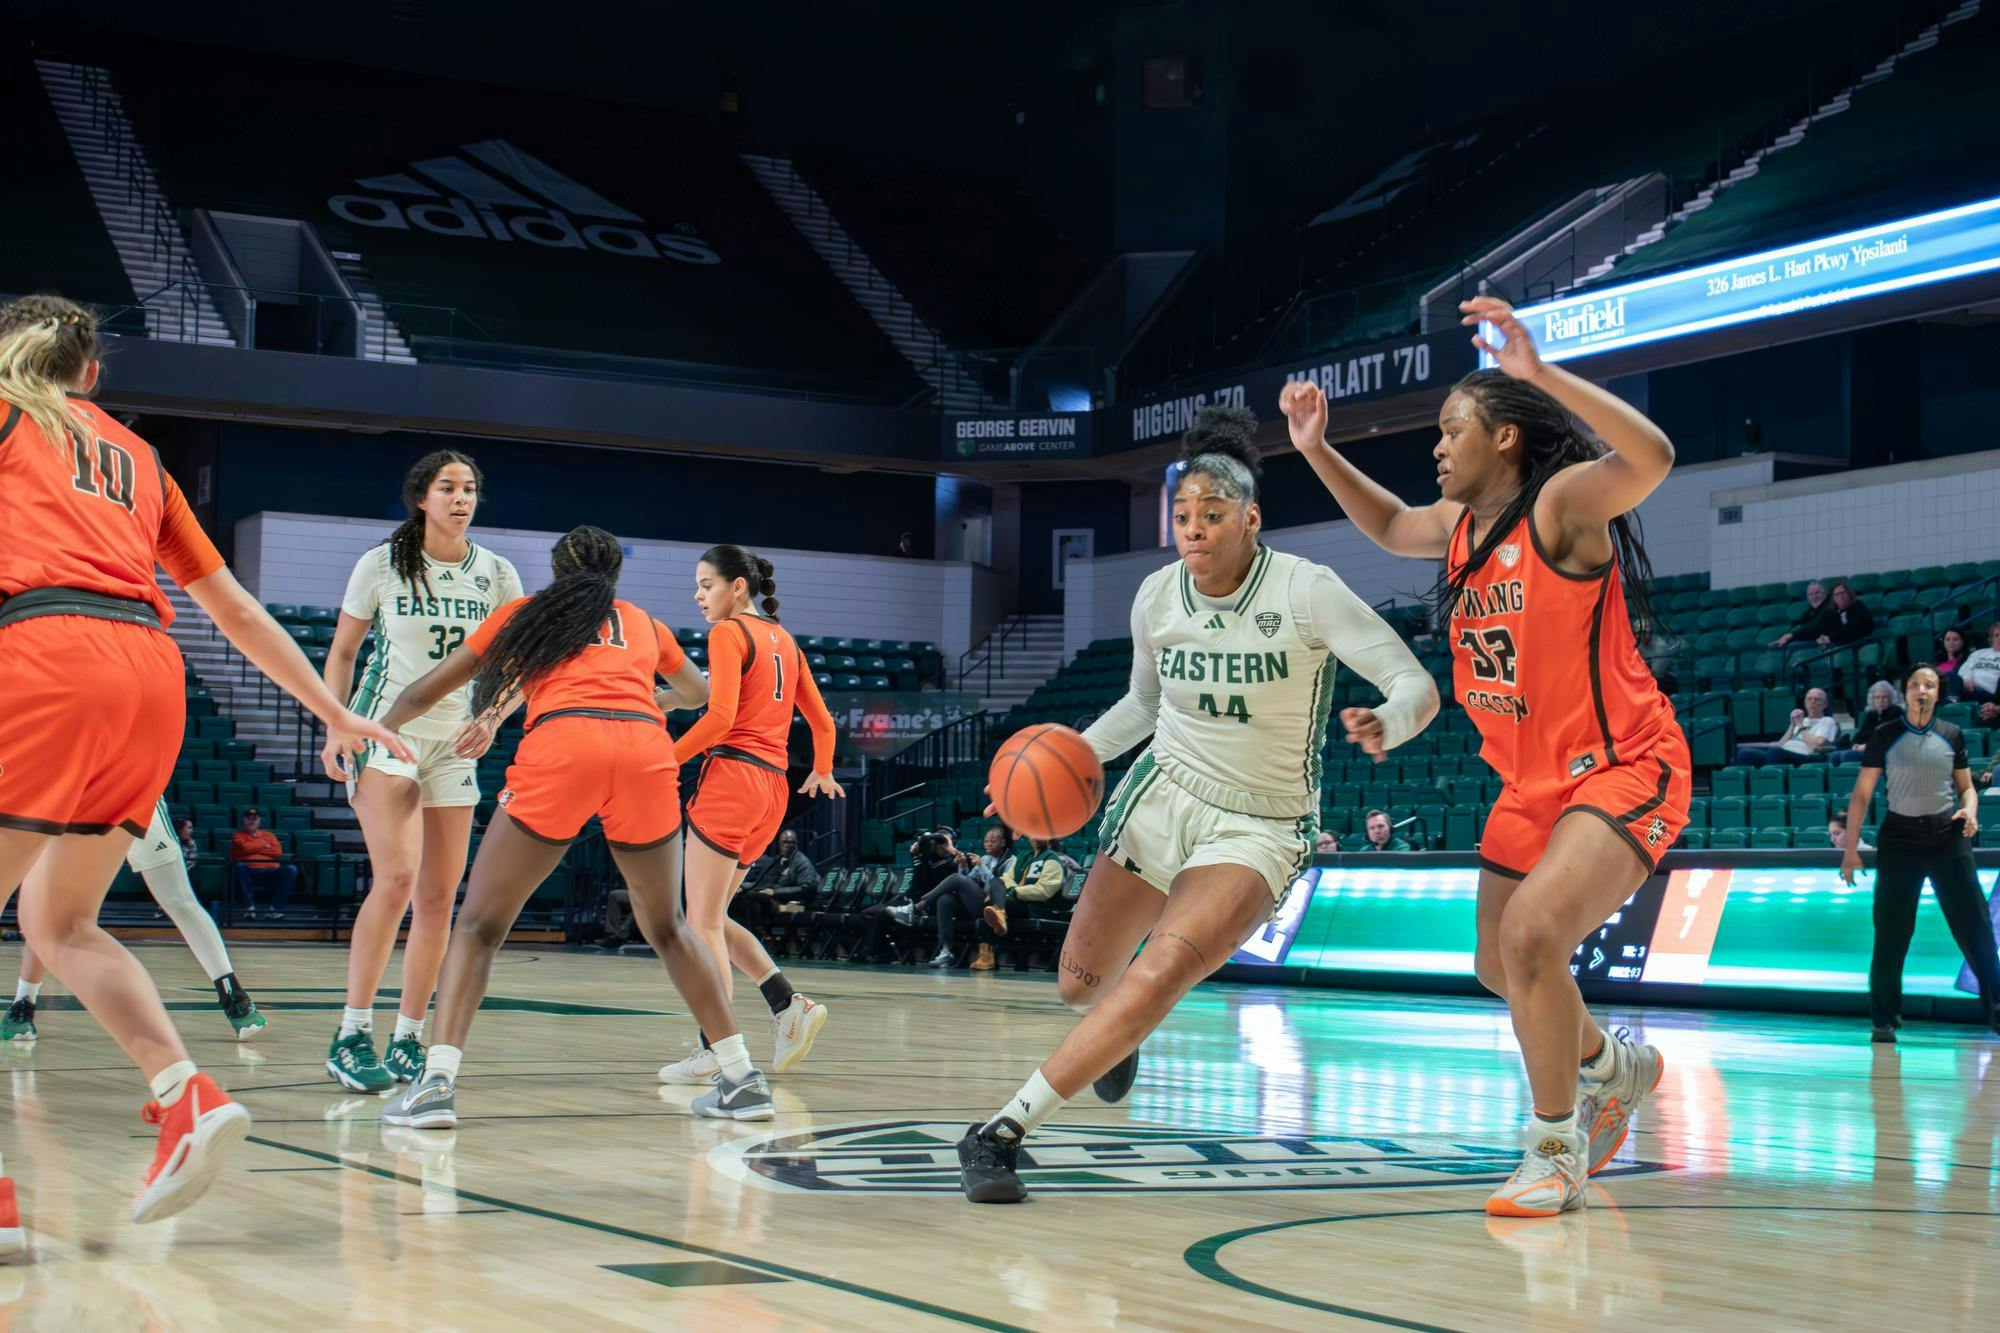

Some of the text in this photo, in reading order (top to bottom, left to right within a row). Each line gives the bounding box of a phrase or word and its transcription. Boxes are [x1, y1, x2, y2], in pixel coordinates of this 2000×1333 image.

[327, 194, 722, 264] adidas
[1706, 234, 1909, 297] 326 James L. Hart Pkwy Ypsilanti
[1544, 297, 1626, 342] Fairfield
[1392, 343, 1430, 385] '70
[956, 417, 1076, 439] GEORGE GERVIN
[977, 440, 1077, 453] GAMEABOVE CENTER
[63, 421, 137, 516] 10
[396, 595, 491, 622] EASTERN
[589, 608, 628, 650] 1
[428, 624, 466, 661] 32
[772, 652, 784, 702] 1
[1160, 647, 1290, 685] EASTERN
[849, 707, 944, 730] Frame's
